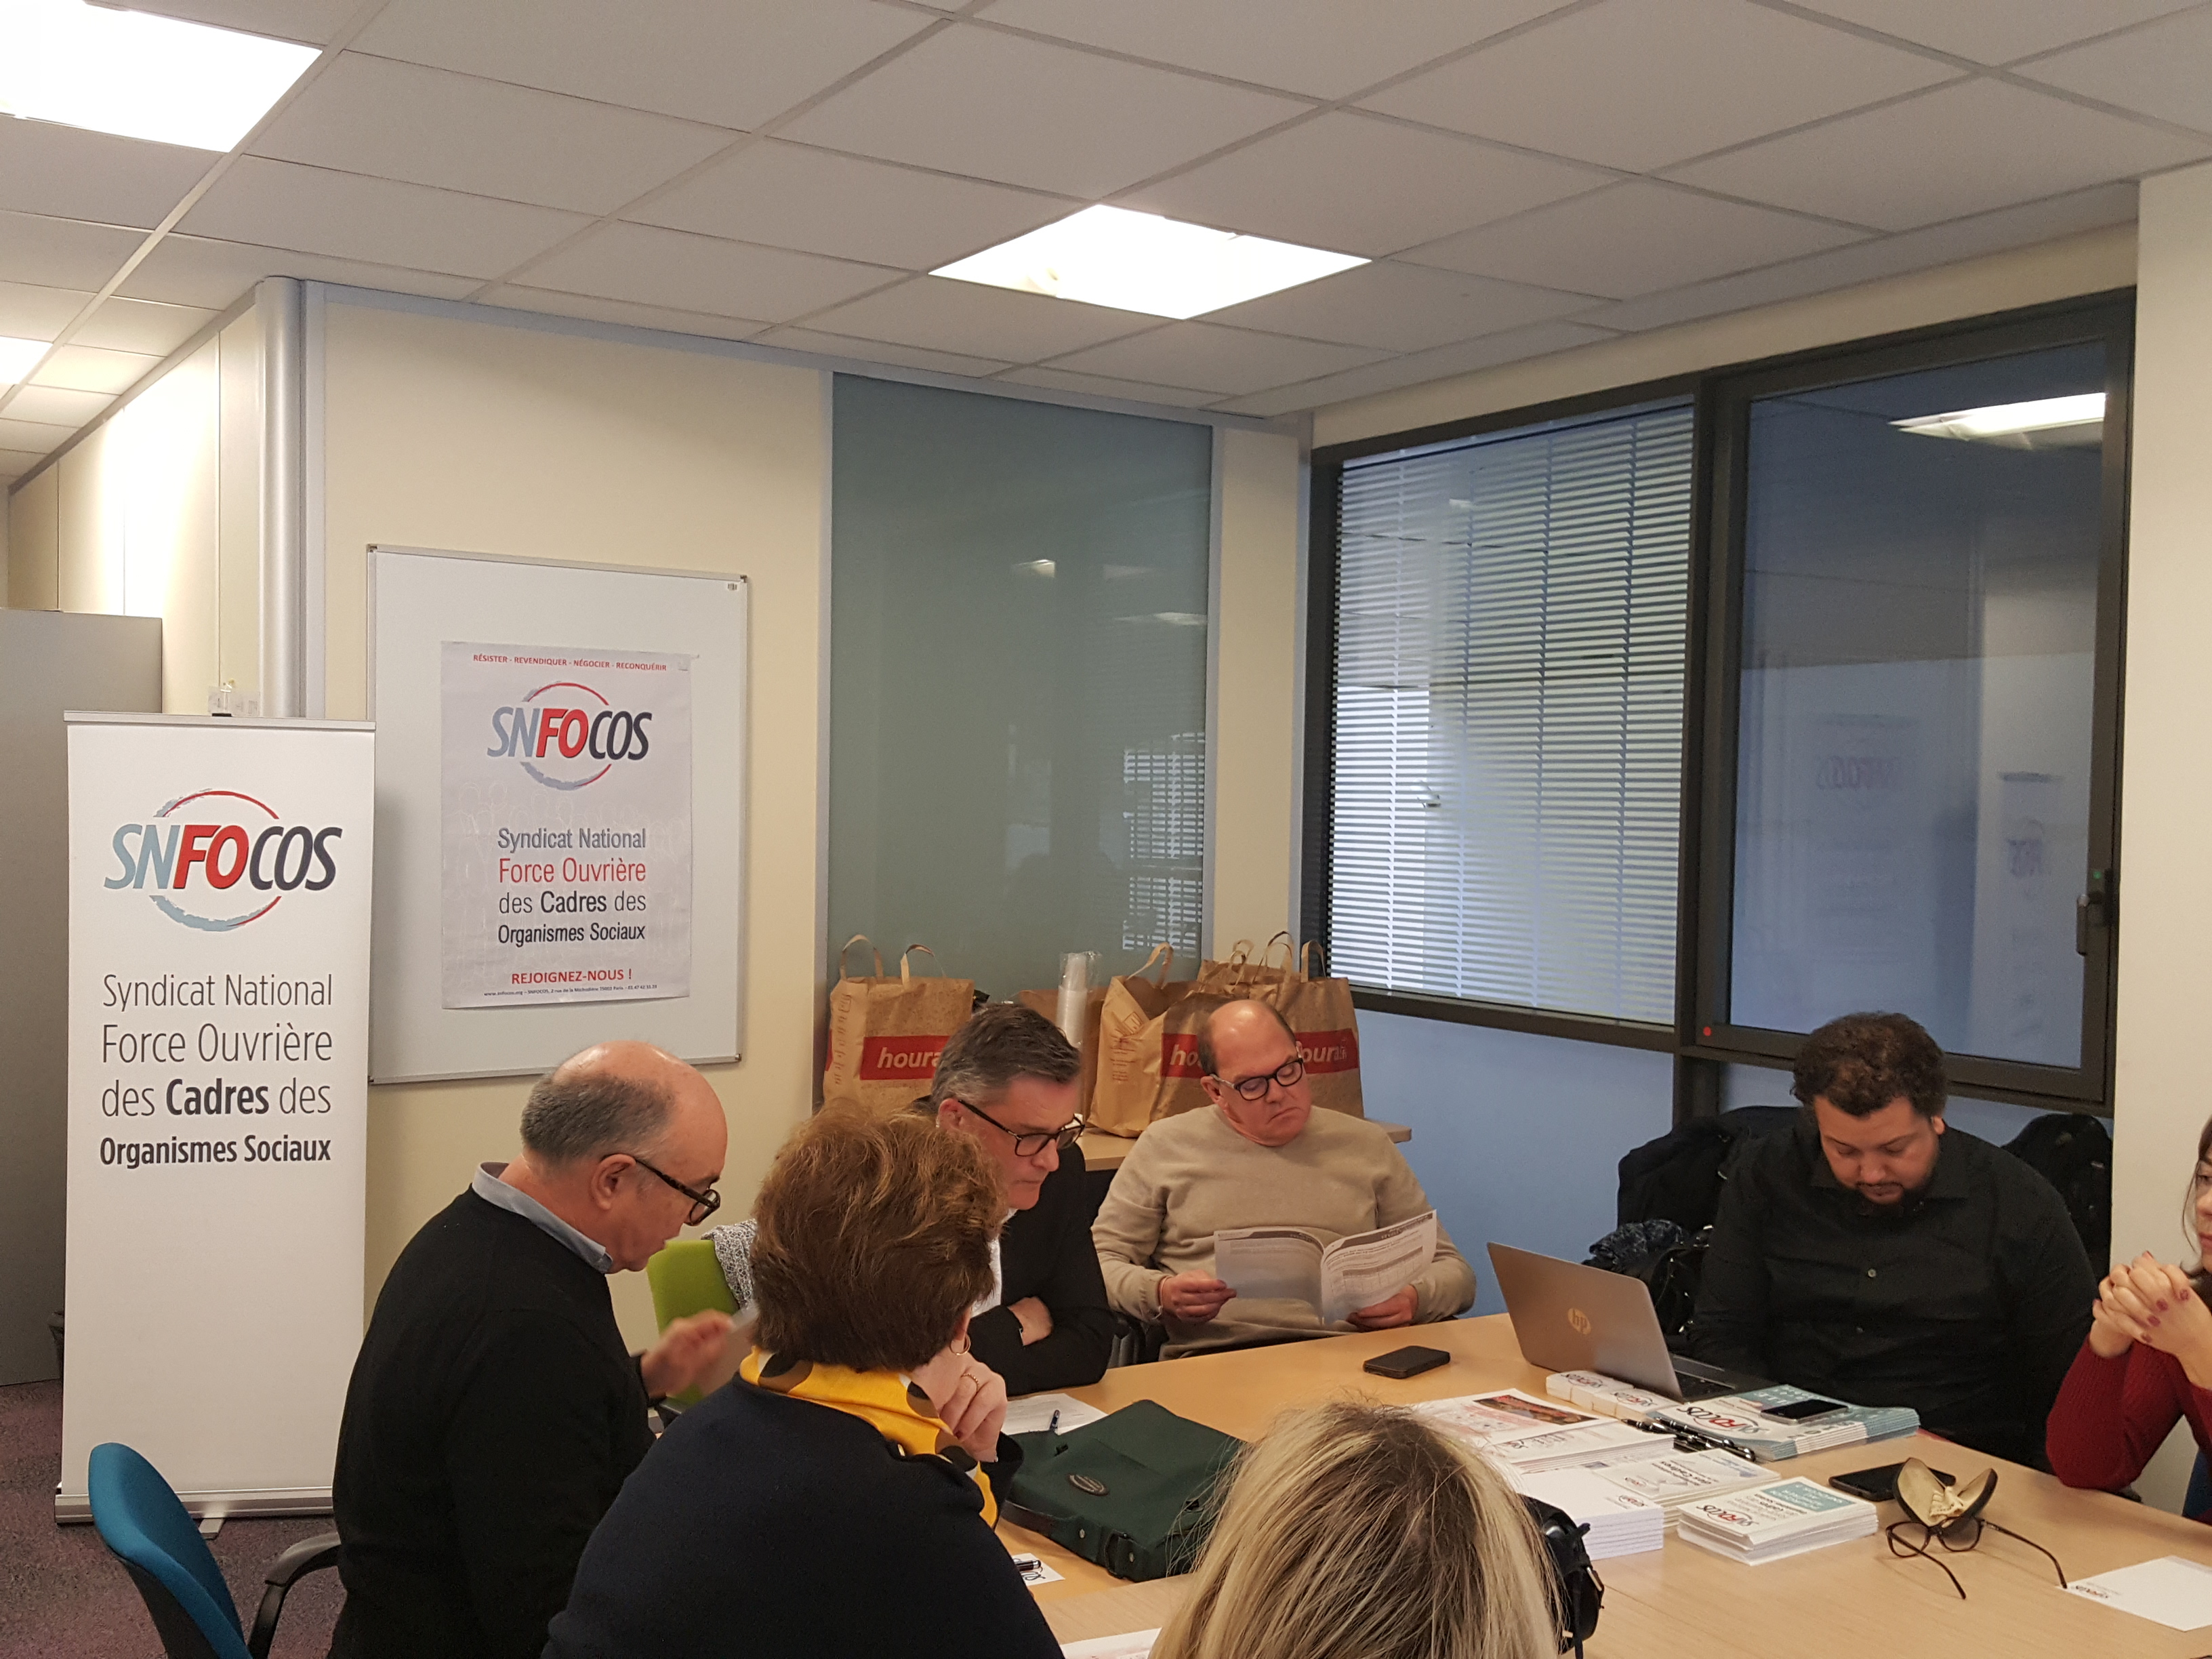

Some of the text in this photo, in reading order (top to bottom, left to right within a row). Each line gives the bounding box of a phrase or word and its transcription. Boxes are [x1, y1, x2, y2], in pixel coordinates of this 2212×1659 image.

[473, 653, 667, 671] RÉSISTER REVENDIQUER NÉGOCIER RECONQUÉRIR
[487, 706, 653, 761] SNFOCOS
[497, 827, 646, 854] Syndicat National
[104, 823, 343, 891] SNFOCOS
[499, 857, 646, 883] Force Ouvrière
[499, 890, 647, 914] des Cadres des
[498, 922, 646, 948] Organismes Sociaux
[512, 969, 624, 985] REJOIGNEZ-NOUS
[103, 973, 332, 1012] Syndicat National
[103, 1022, 332, 1063] Force Ouvrière
[102, 1077, 331, 1117] des Cadres des
[100, 1134, 331, 1170] Organismes Sociaux
[1571, 1309, 1589, 1334] hp
